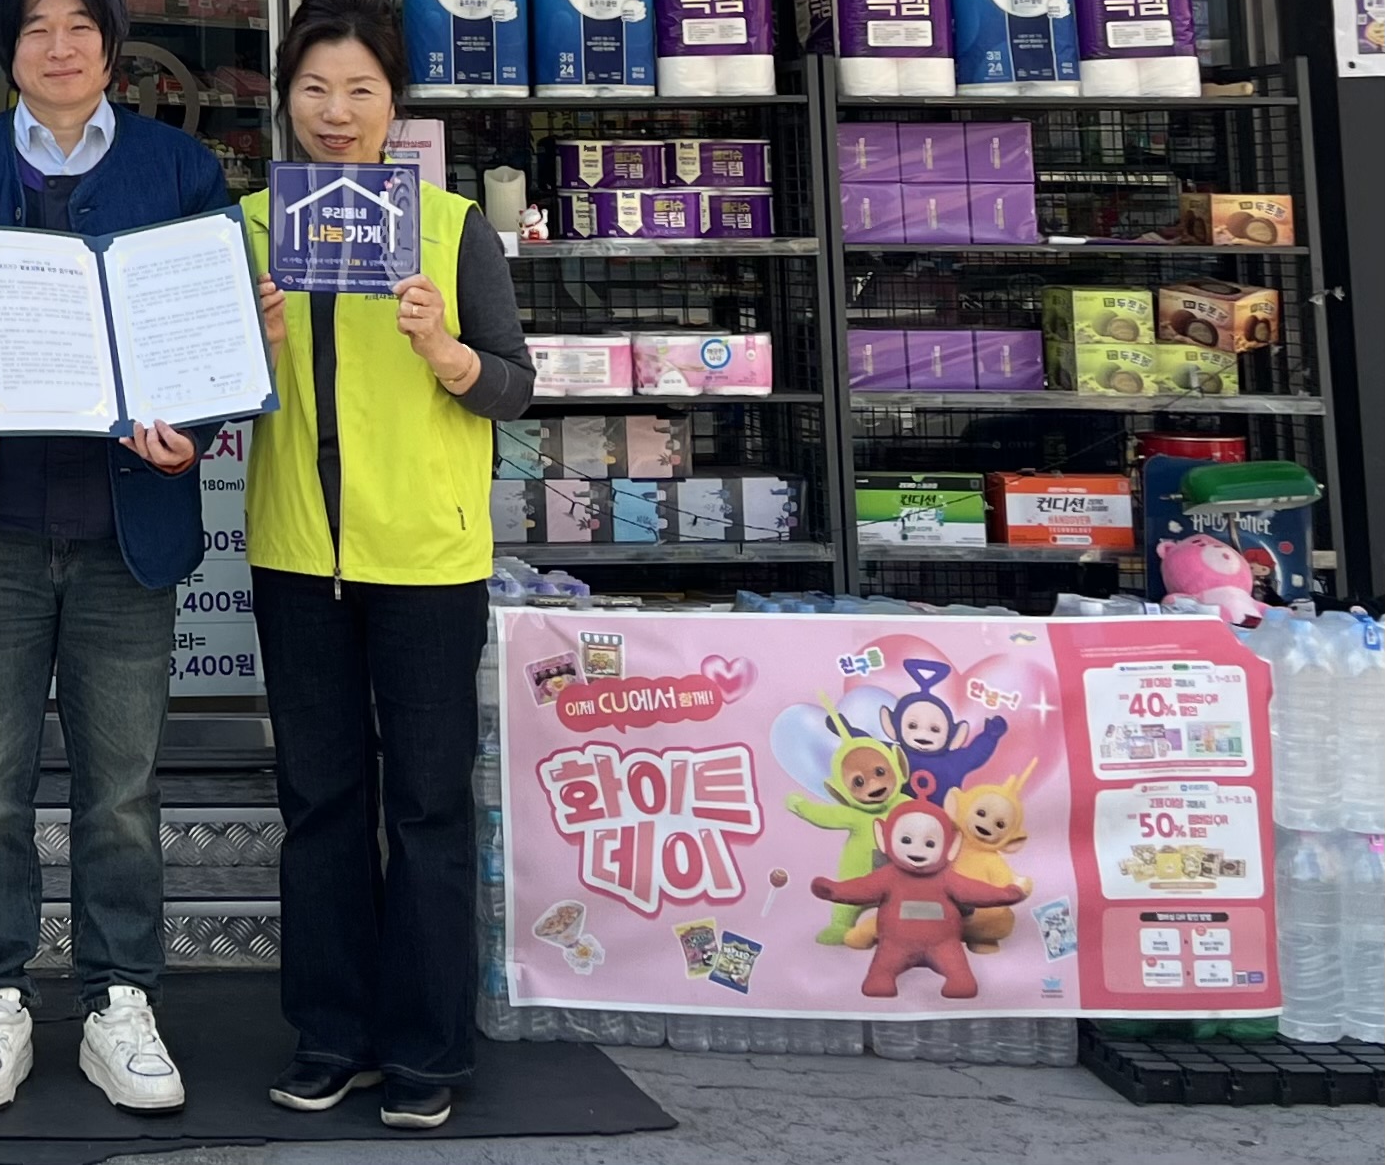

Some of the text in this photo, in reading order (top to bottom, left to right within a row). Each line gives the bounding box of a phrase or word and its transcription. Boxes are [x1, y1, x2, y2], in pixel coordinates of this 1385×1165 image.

[321, 207, 368, 220] 우리동네
[307, 224, 382, 244] 나눔가게
[1037, 497, 1085, 513] 컨디션
[176, 590, 254, 616] ,400원
[839, 649, 883, 675] 친구들
[565, 687, 715, 717] 이제 CU에서 함께!
[1129, 692, 1177, 718] 40%
[548, 753, 754, 828] 화이트
[1139, 812, 1187, 839] 50%
[591, 820, 734, 905] 데이
